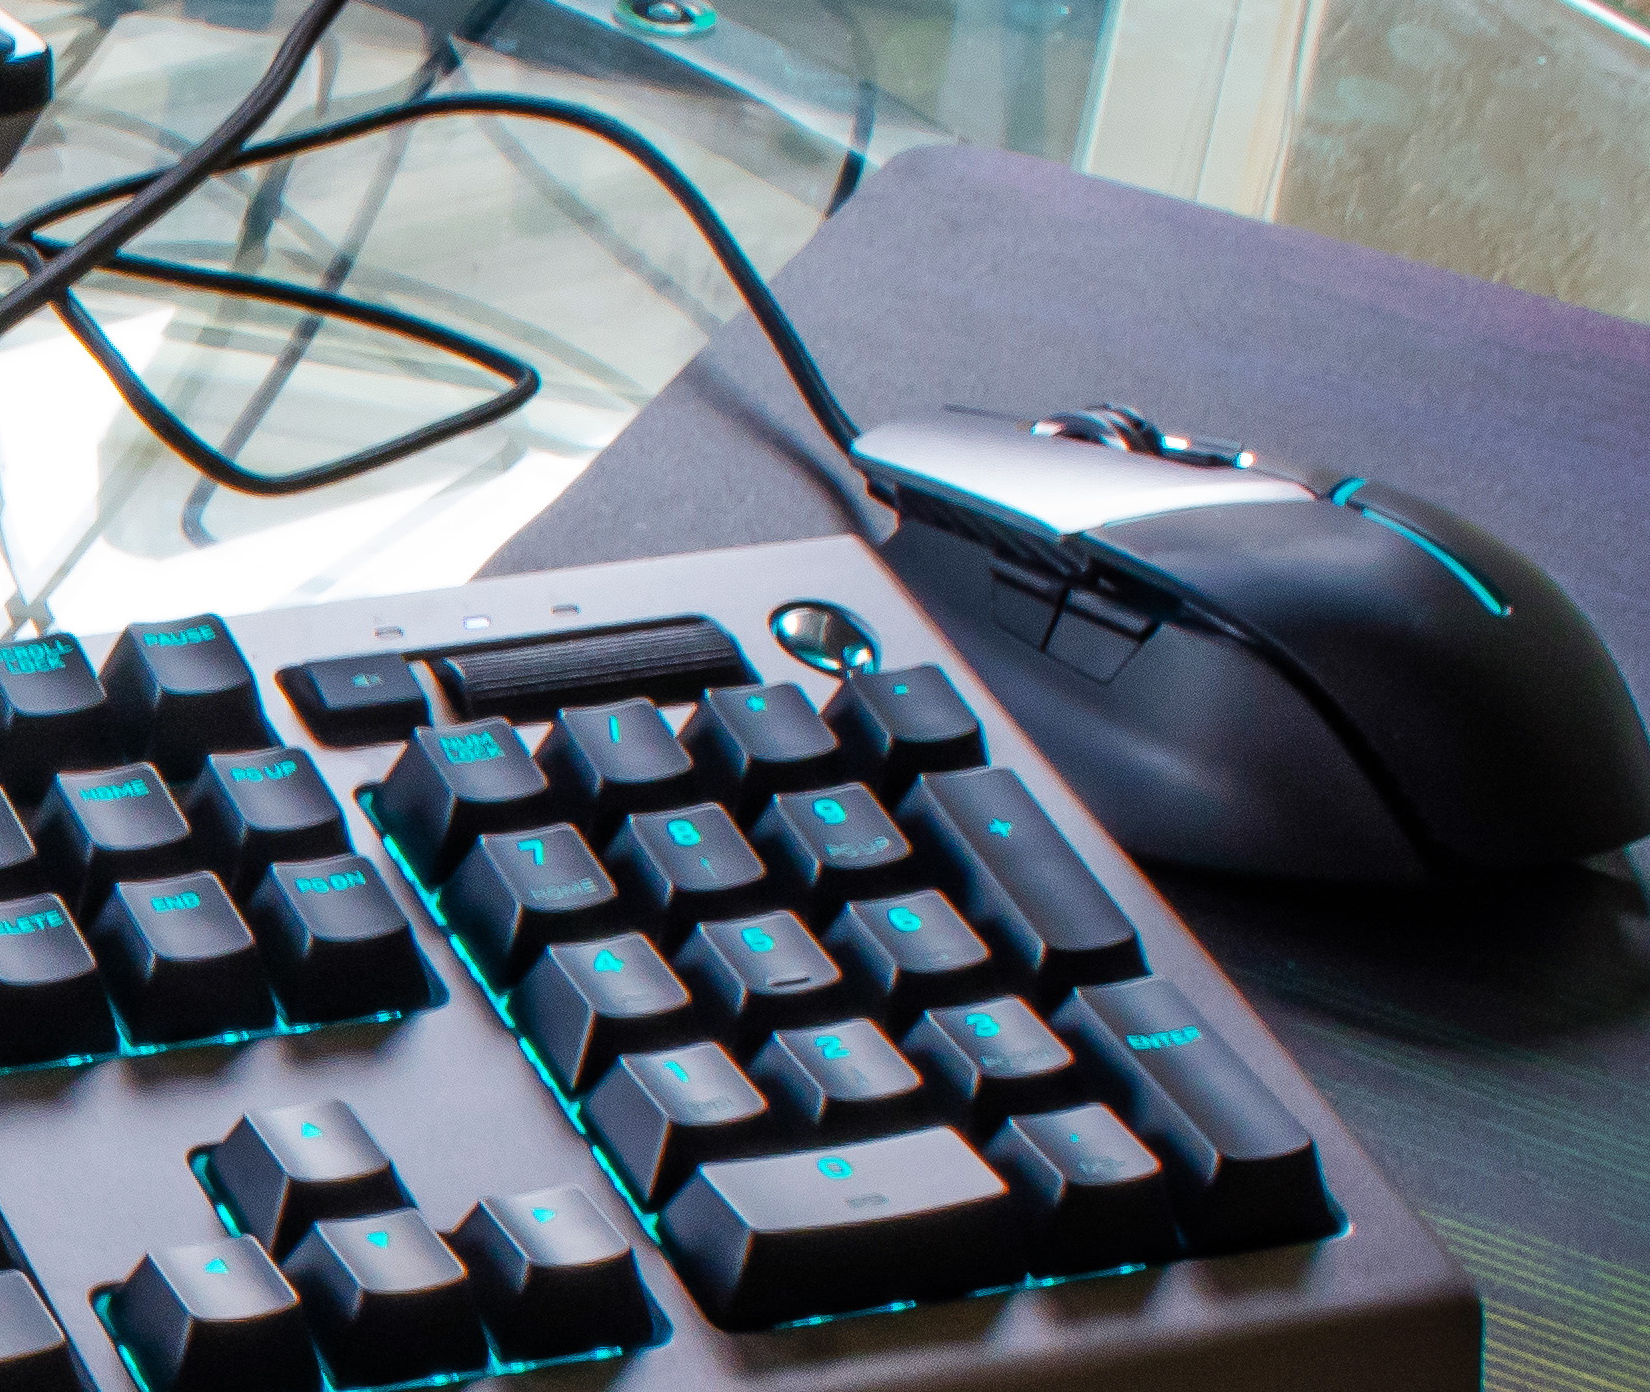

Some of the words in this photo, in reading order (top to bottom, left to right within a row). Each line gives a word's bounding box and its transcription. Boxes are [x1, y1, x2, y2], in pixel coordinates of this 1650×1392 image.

[812, 797, 846, 825] 9
[666, 819, 701, 847] 8
[517, 838, 545, 866] 7
[887, 906, 921, 933] 6
[740, 926, 774, 953] 5
[593, 949, 624, 973] 4
[964, 1012, 1000, 1038] 3
[1126, 1025, 1200, 1050] ENTER
[814, 1035, 849, 1060] 2
[663, 1060, 688, 1082] 1
[817, 1156, 853, 1180] 0
